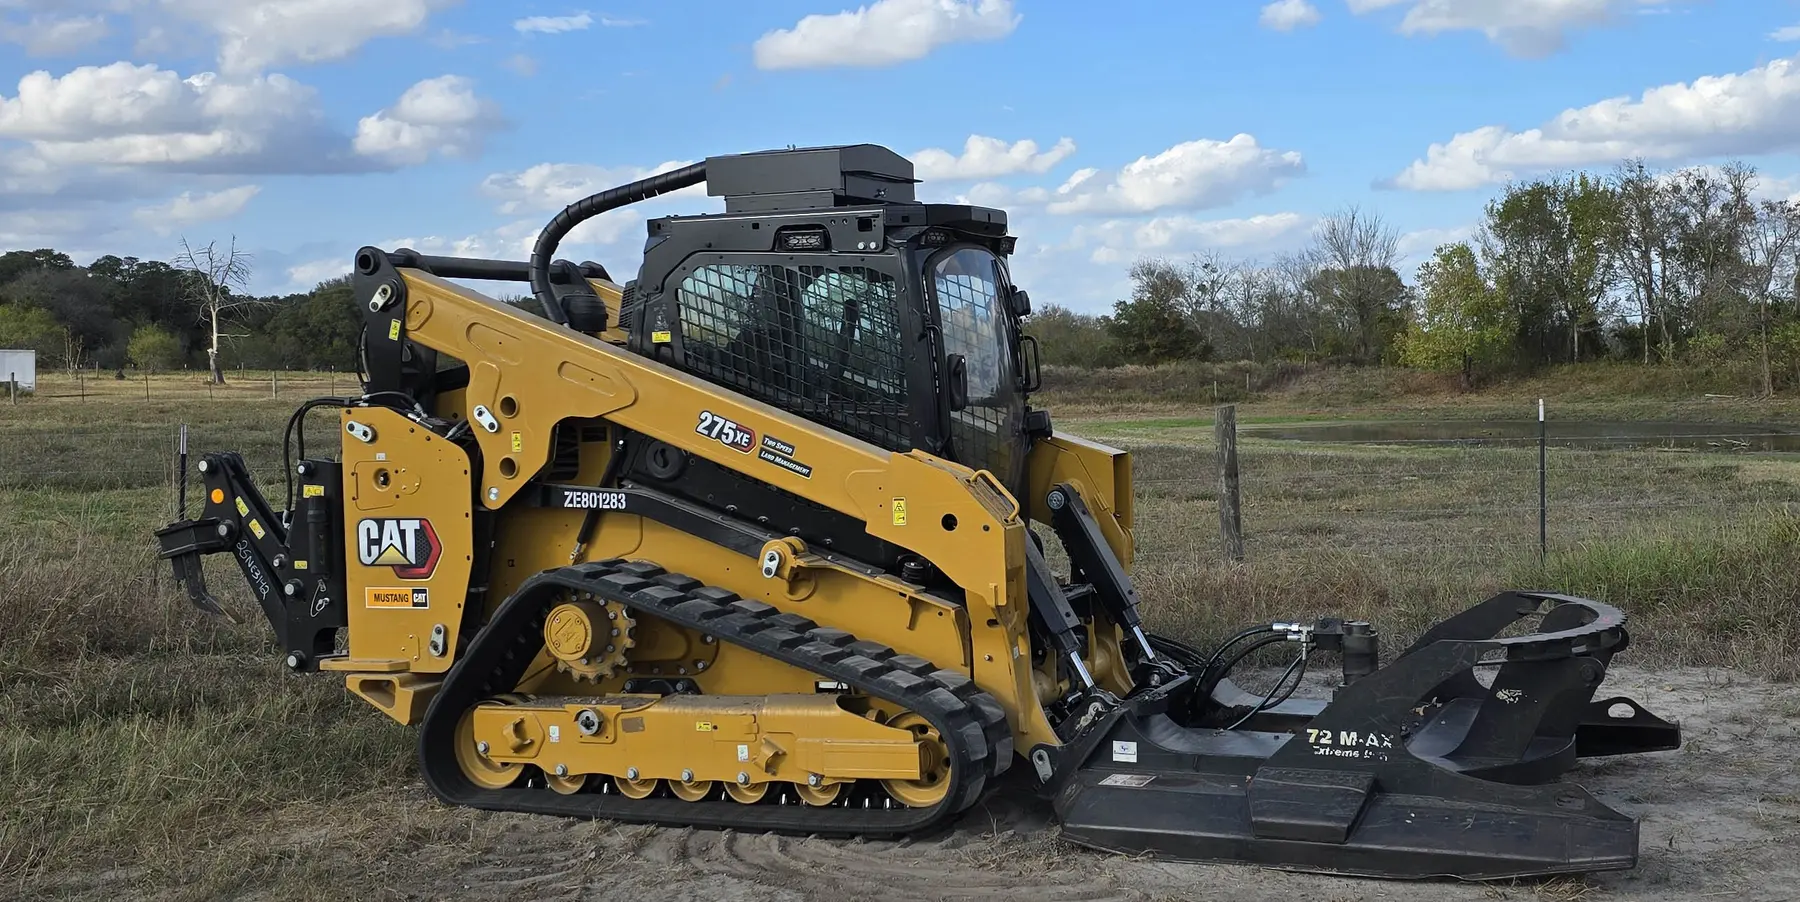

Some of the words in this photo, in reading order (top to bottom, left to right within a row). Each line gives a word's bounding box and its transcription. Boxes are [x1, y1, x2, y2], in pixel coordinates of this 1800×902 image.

[563, 491, 627, 510] ZE801283
[358, 519, 420, 565] CAT
[373, 593, 409, 603] MUSTANG
[413, 593, 427, 603] CAT
[1306, 728, 1332, 745] 72
